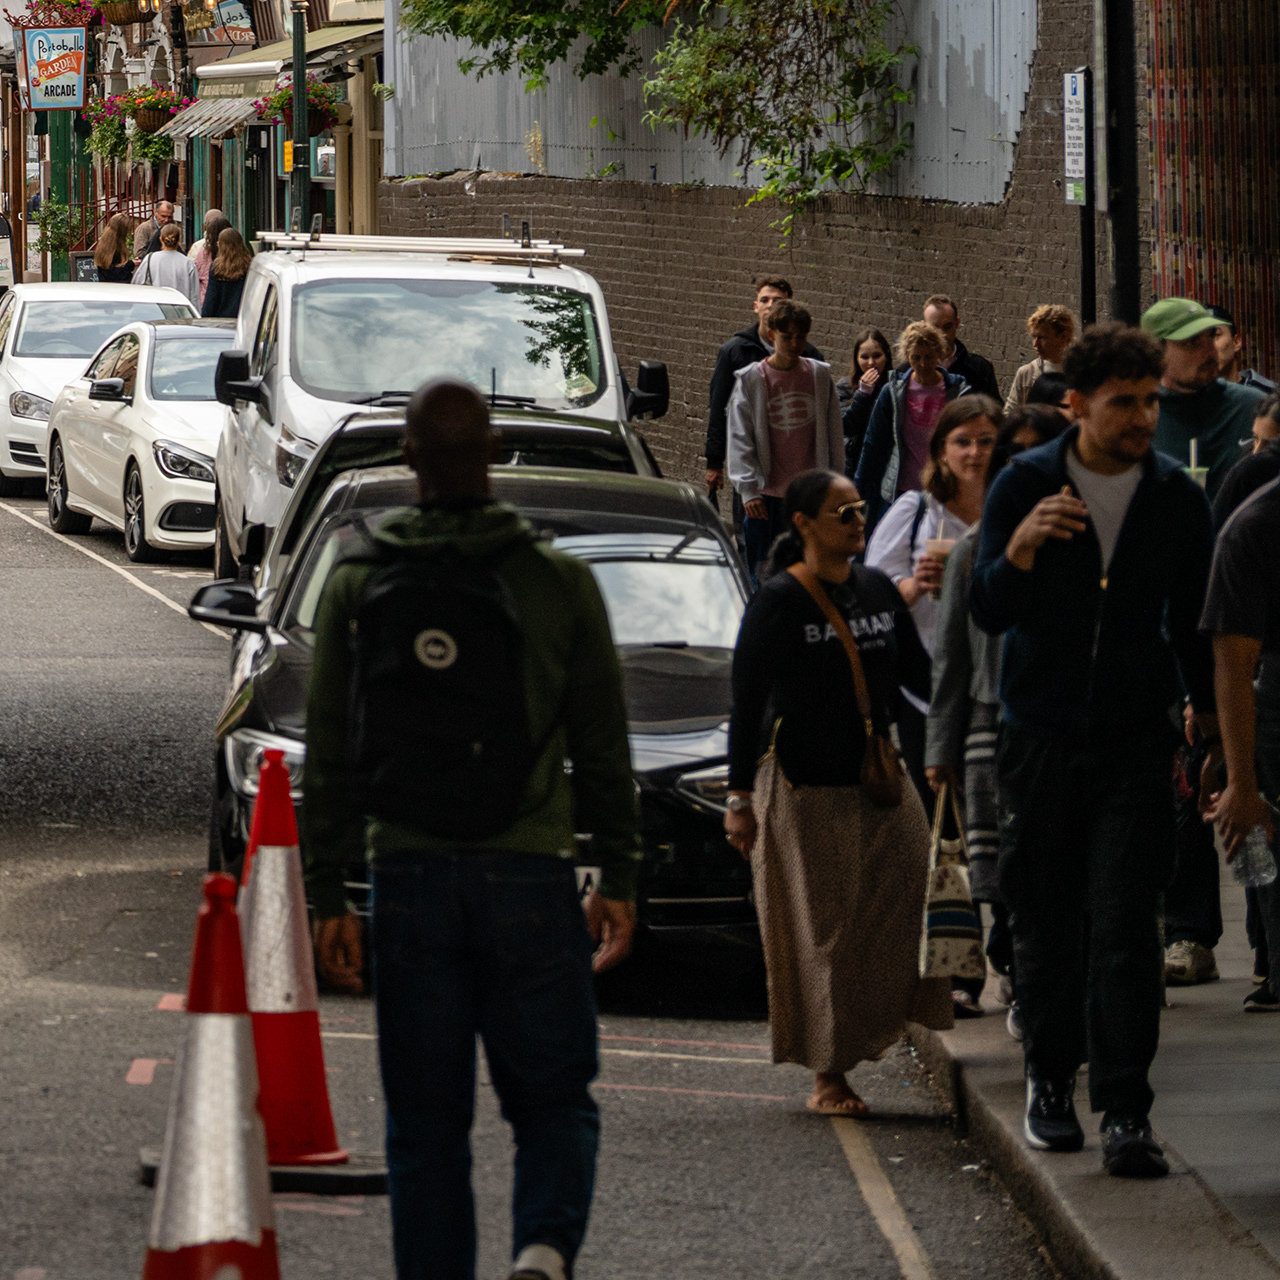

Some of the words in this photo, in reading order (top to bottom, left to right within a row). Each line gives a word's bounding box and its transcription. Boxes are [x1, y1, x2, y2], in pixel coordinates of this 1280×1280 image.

[38, 35, 85, 59] Portobello
[40, 55, 78, 77] GARDEN
[44, 84, 76, 97] ARCADE
